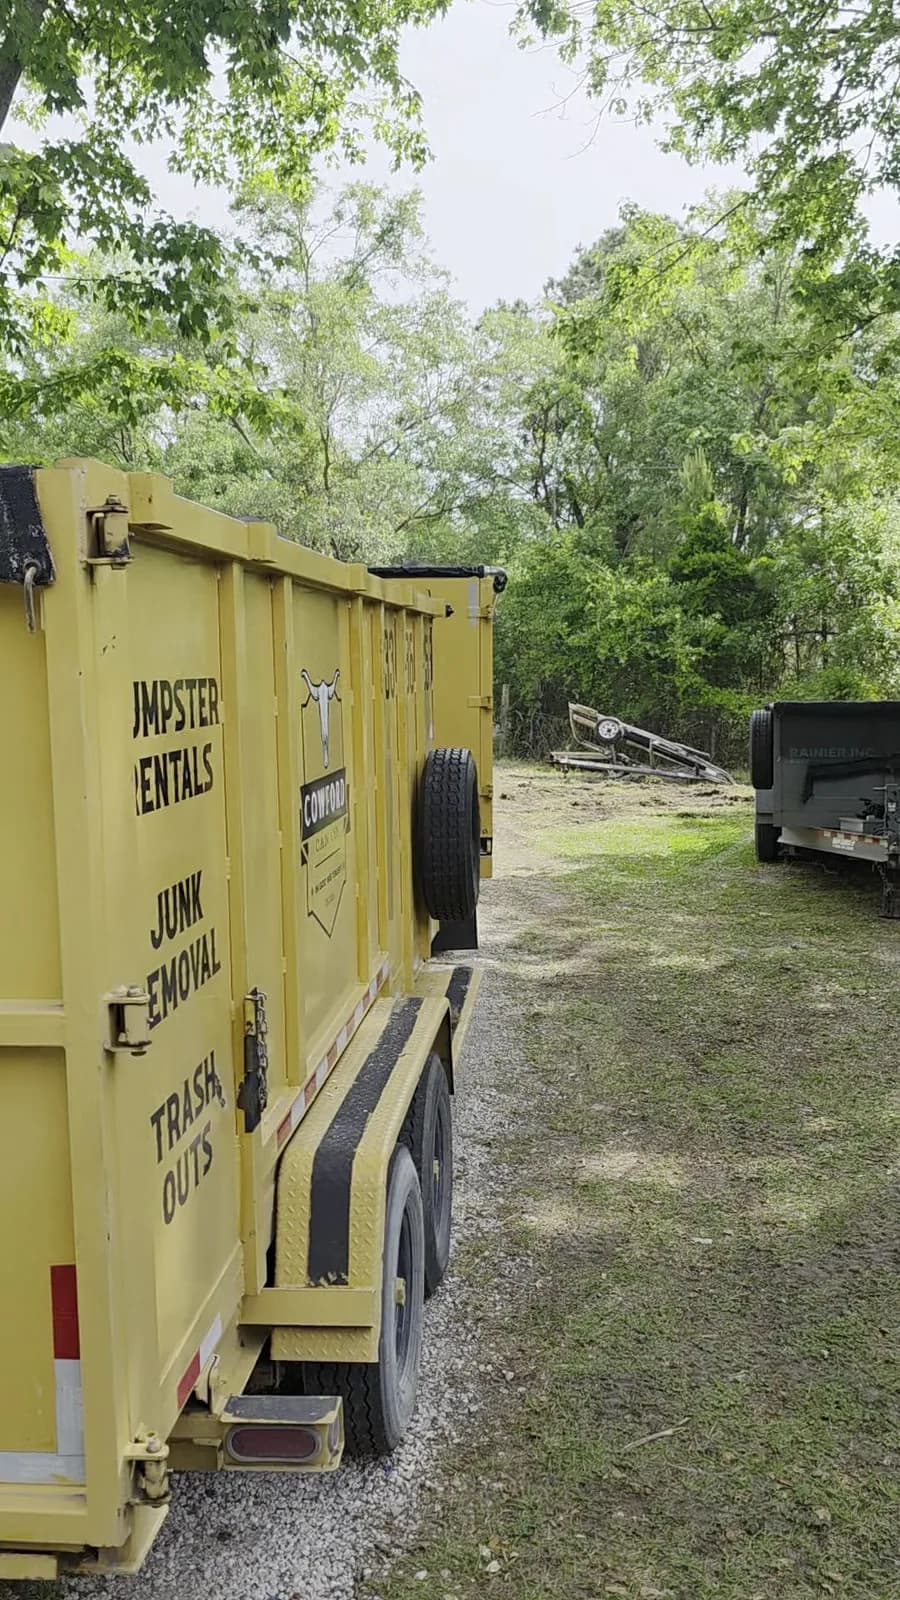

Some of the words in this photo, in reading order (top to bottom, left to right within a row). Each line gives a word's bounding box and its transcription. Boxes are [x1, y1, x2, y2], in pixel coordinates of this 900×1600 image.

[789, 746, 847, 759] RAINIER
[304, 778, 345, 828] COWFORD
[150, 869, 204, 951] JUNK
[150, 1049, 217, 1164] TRASH
[163, 1120, 214, 1225] OUTS
